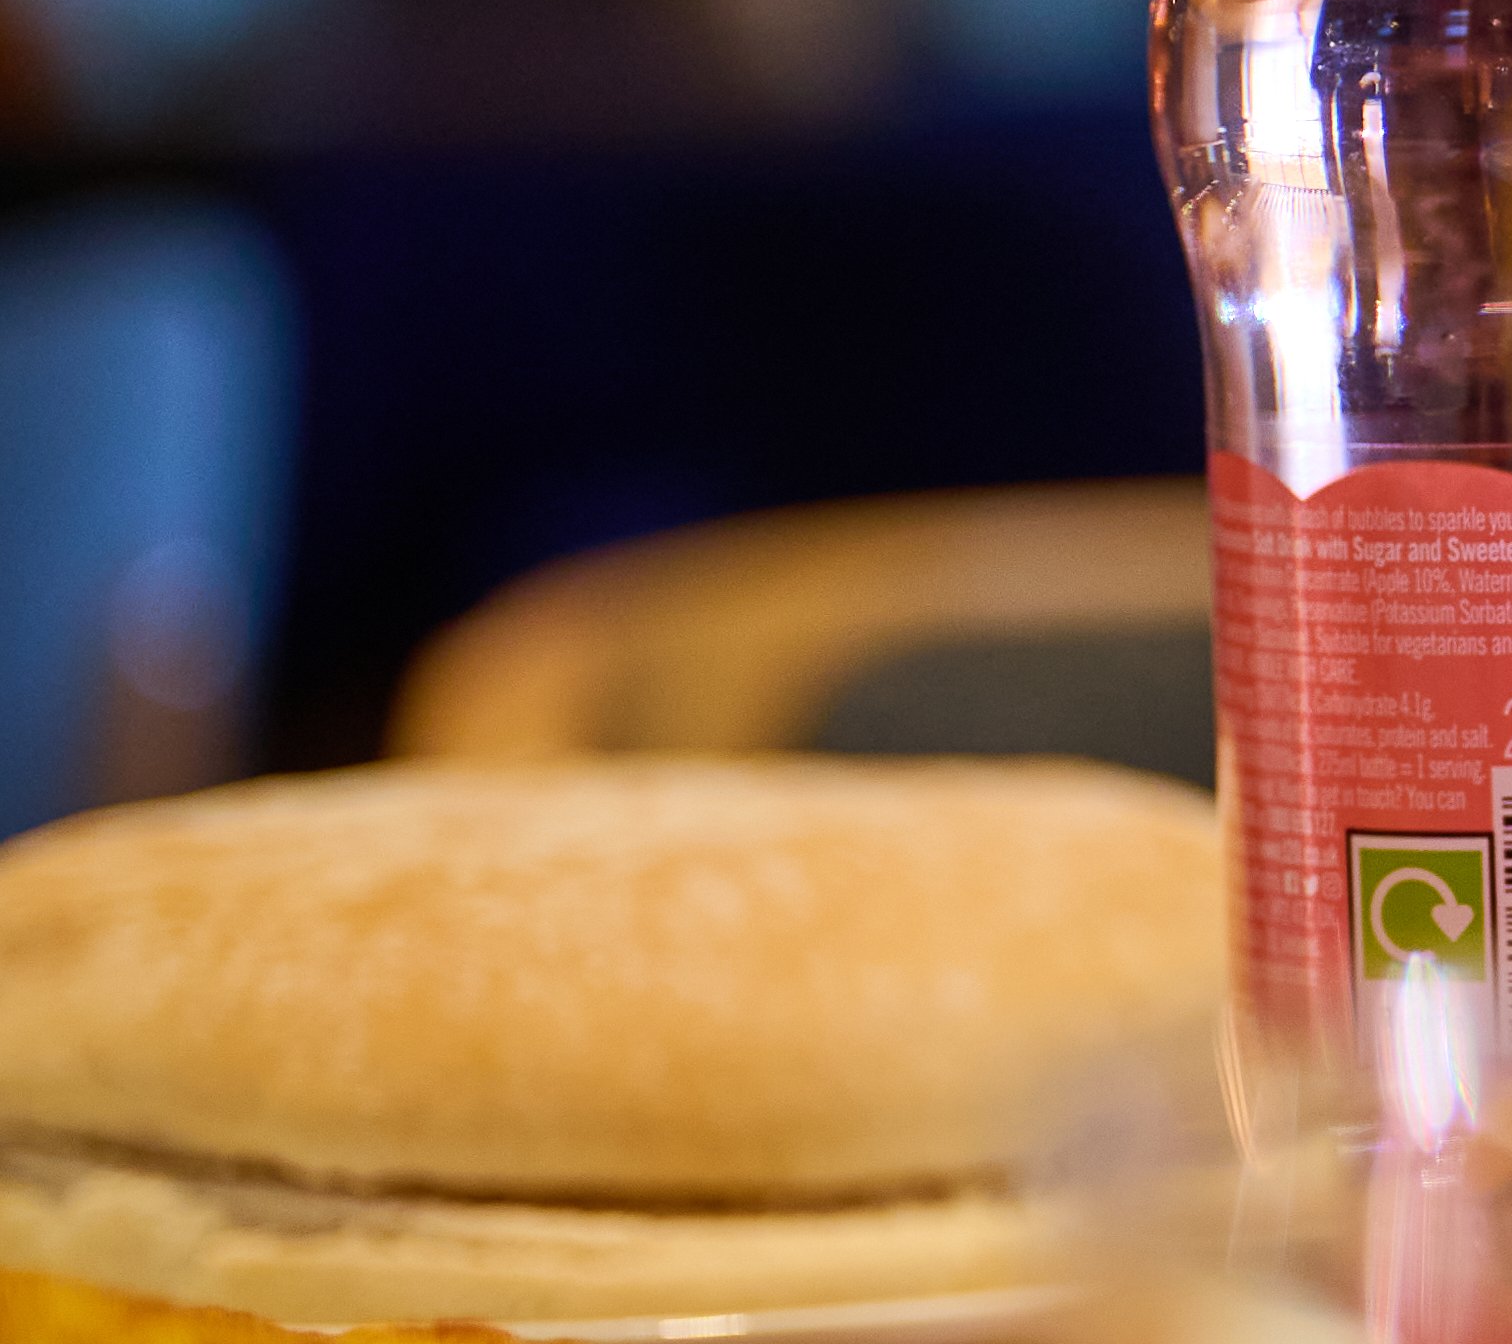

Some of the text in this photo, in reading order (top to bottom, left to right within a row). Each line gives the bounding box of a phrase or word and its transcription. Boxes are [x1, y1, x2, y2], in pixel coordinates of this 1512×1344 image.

[1427, 505, 1485, 538] sparkle
[1314, 535, 1348, 560] with
[1352, 536, 1400, 567] Sugar
[1407, 537, 1441, 562] and
[1369, 598, 1456, 626] (Potassium
[1394, 630, 1487, 660] vegetarians
[1428, 724, 1459, 749] and
[1405, 786, 1433, 810] You
[1435, 789, 1466, 810] can
